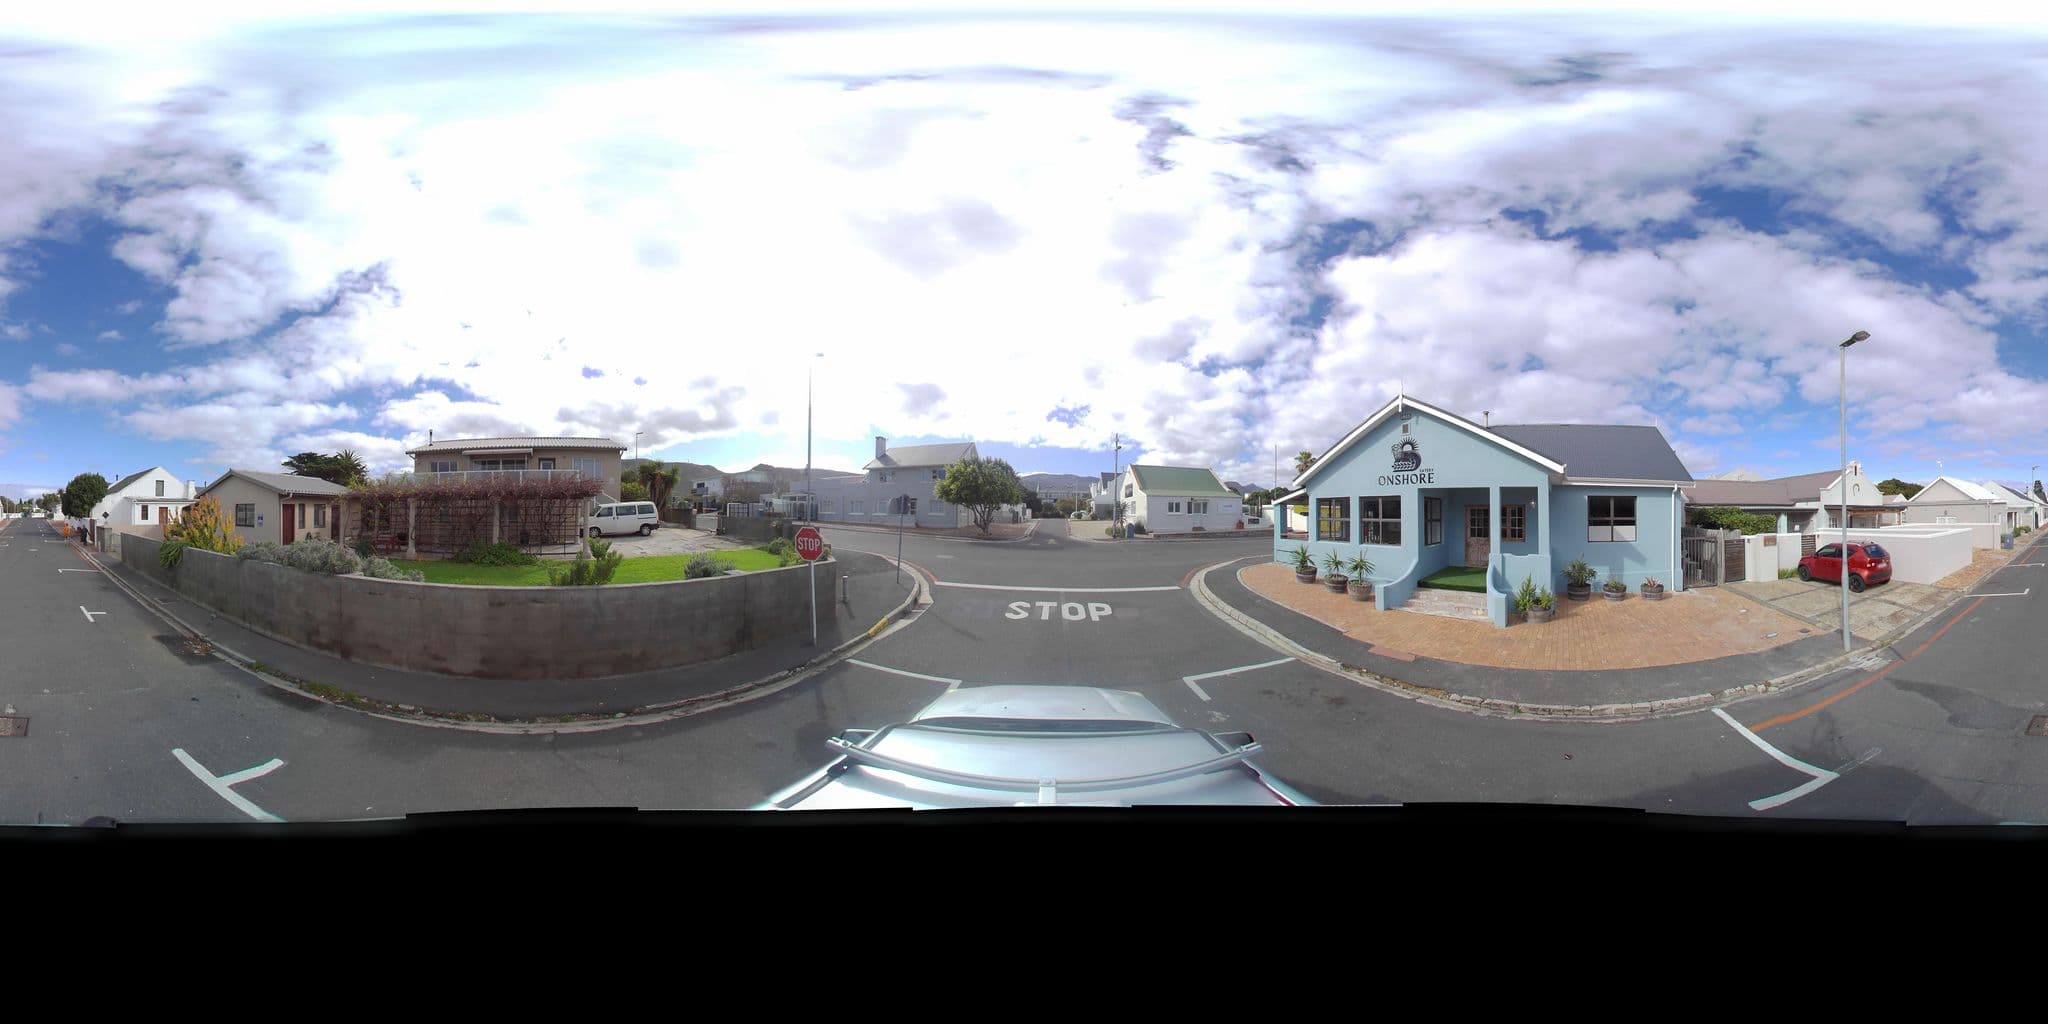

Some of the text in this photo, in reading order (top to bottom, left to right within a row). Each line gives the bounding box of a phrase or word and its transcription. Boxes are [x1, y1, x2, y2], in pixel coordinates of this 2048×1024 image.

[1378, 473, 1434, 486] ONSHORE
[798, 537, 820, 551] STOP
[1005, 601, 1112, 621] STOP
